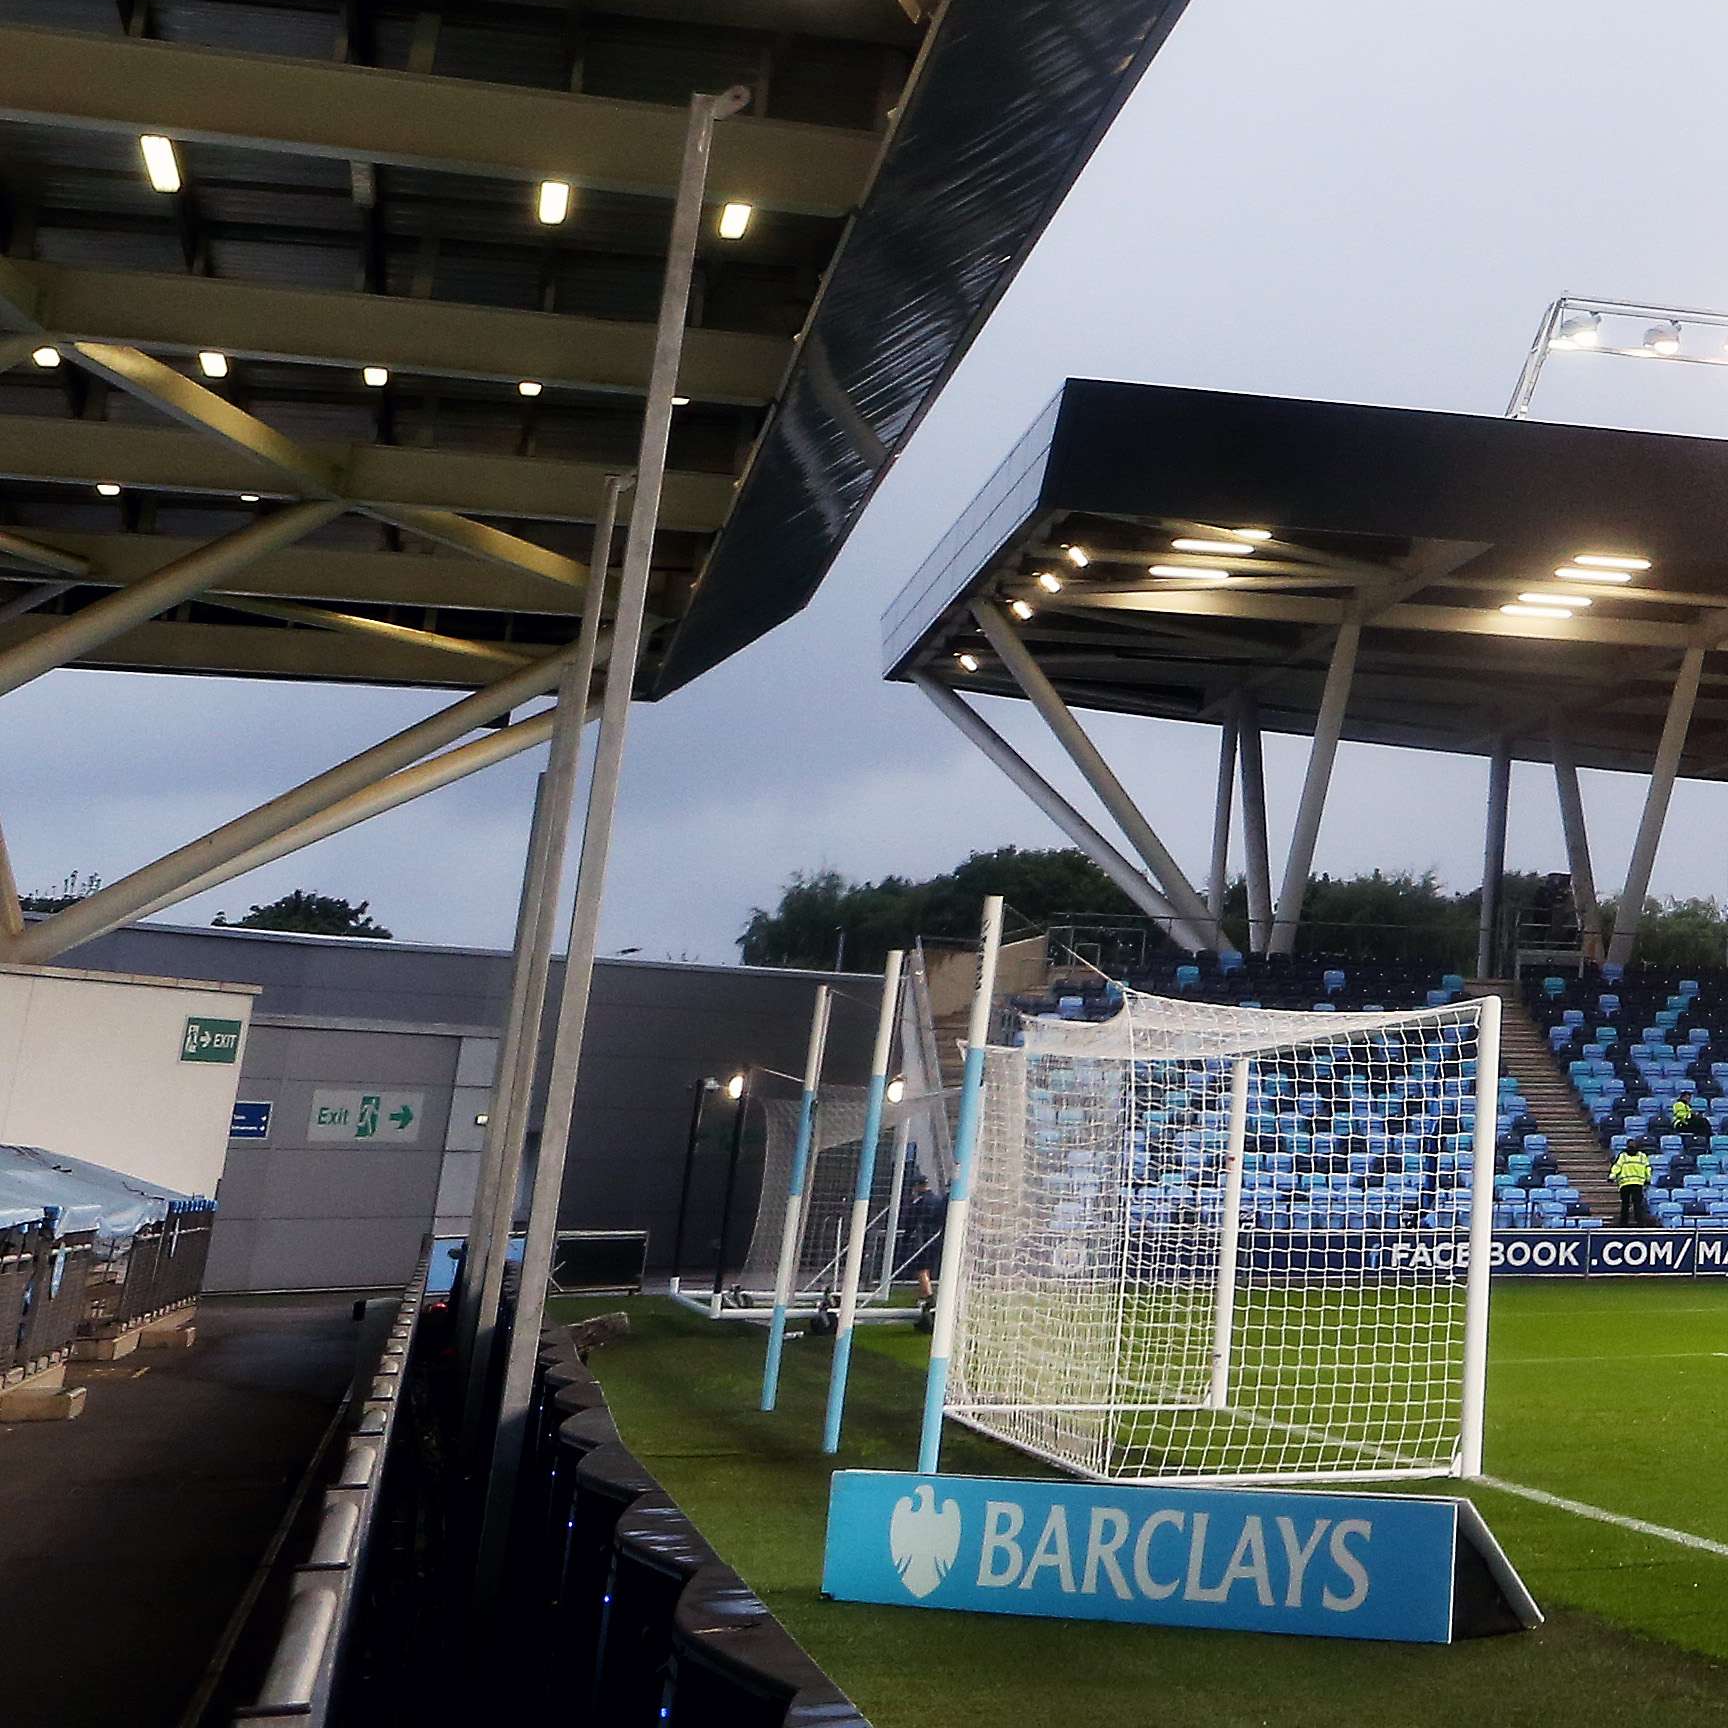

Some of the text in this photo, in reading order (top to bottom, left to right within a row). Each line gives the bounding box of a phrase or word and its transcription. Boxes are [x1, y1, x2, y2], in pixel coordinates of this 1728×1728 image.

[213, 1033, 237, 1048] EXIT
[318, 1106, 349, 1126] Exit
[976, 1499, 1375, 1613] BARCLAYS
